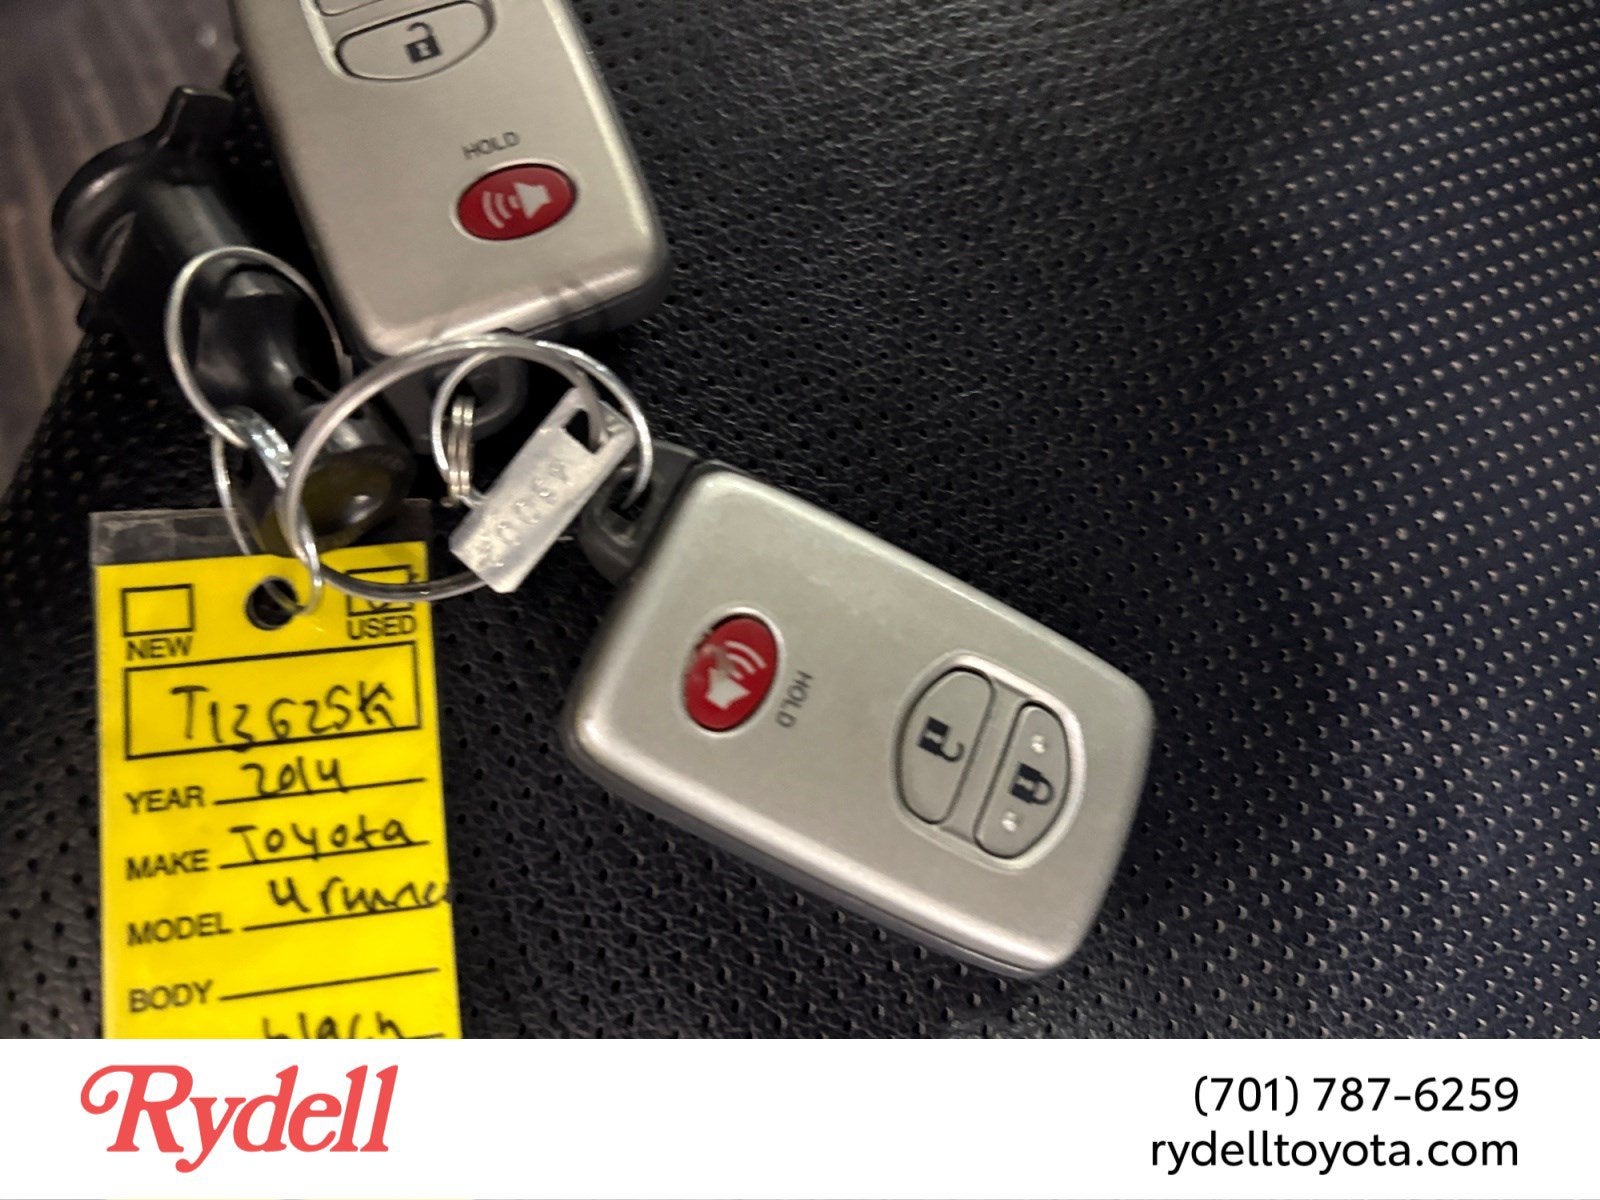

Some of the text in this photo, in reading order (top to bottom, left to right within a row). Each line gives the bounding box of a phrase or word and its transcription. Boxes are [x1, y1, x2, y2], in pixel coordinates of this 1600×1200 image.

[463, 131, 520, 160] HOLD
[348, 615, 417, 640] USED
[125, 636, 193, 661] NEW
[776, 670, 813, 729] HOLD
[240, 756, 349, 798] 2014
[124, 785, 206, 814] YEAR
[228, 814, 418, 862] Toyota
[124, 849, 210, 881] MAKE
[126, 912, 233, 946] MODEL
[128, 979, 214, 1014] BODY
